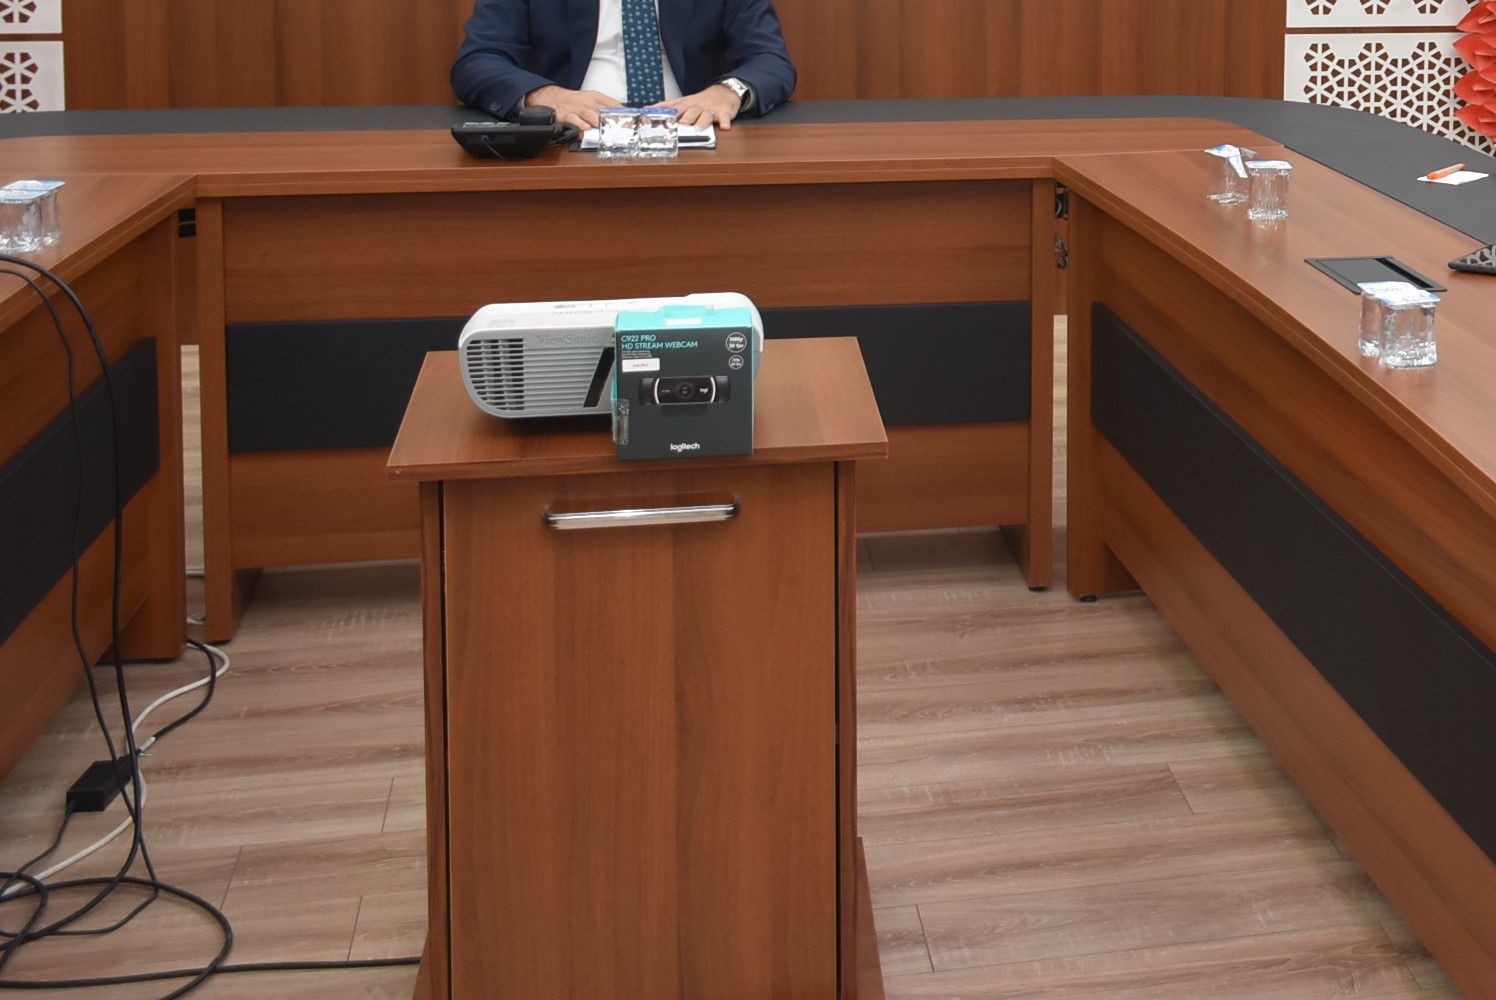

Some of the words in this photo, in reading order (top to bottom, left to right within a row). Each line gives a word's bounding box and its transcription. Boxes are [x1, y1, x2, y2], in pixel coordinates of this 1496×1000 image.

[536, 333, 599, 345] ViewSonic
[621, 334, 639, 342] C922
[621, 342, 633, 350] HD
[635, 341, 664, 349] STREAM
[665, 340, 698, 348] WEBCAM
[670, 442, 700, 452] logitech
